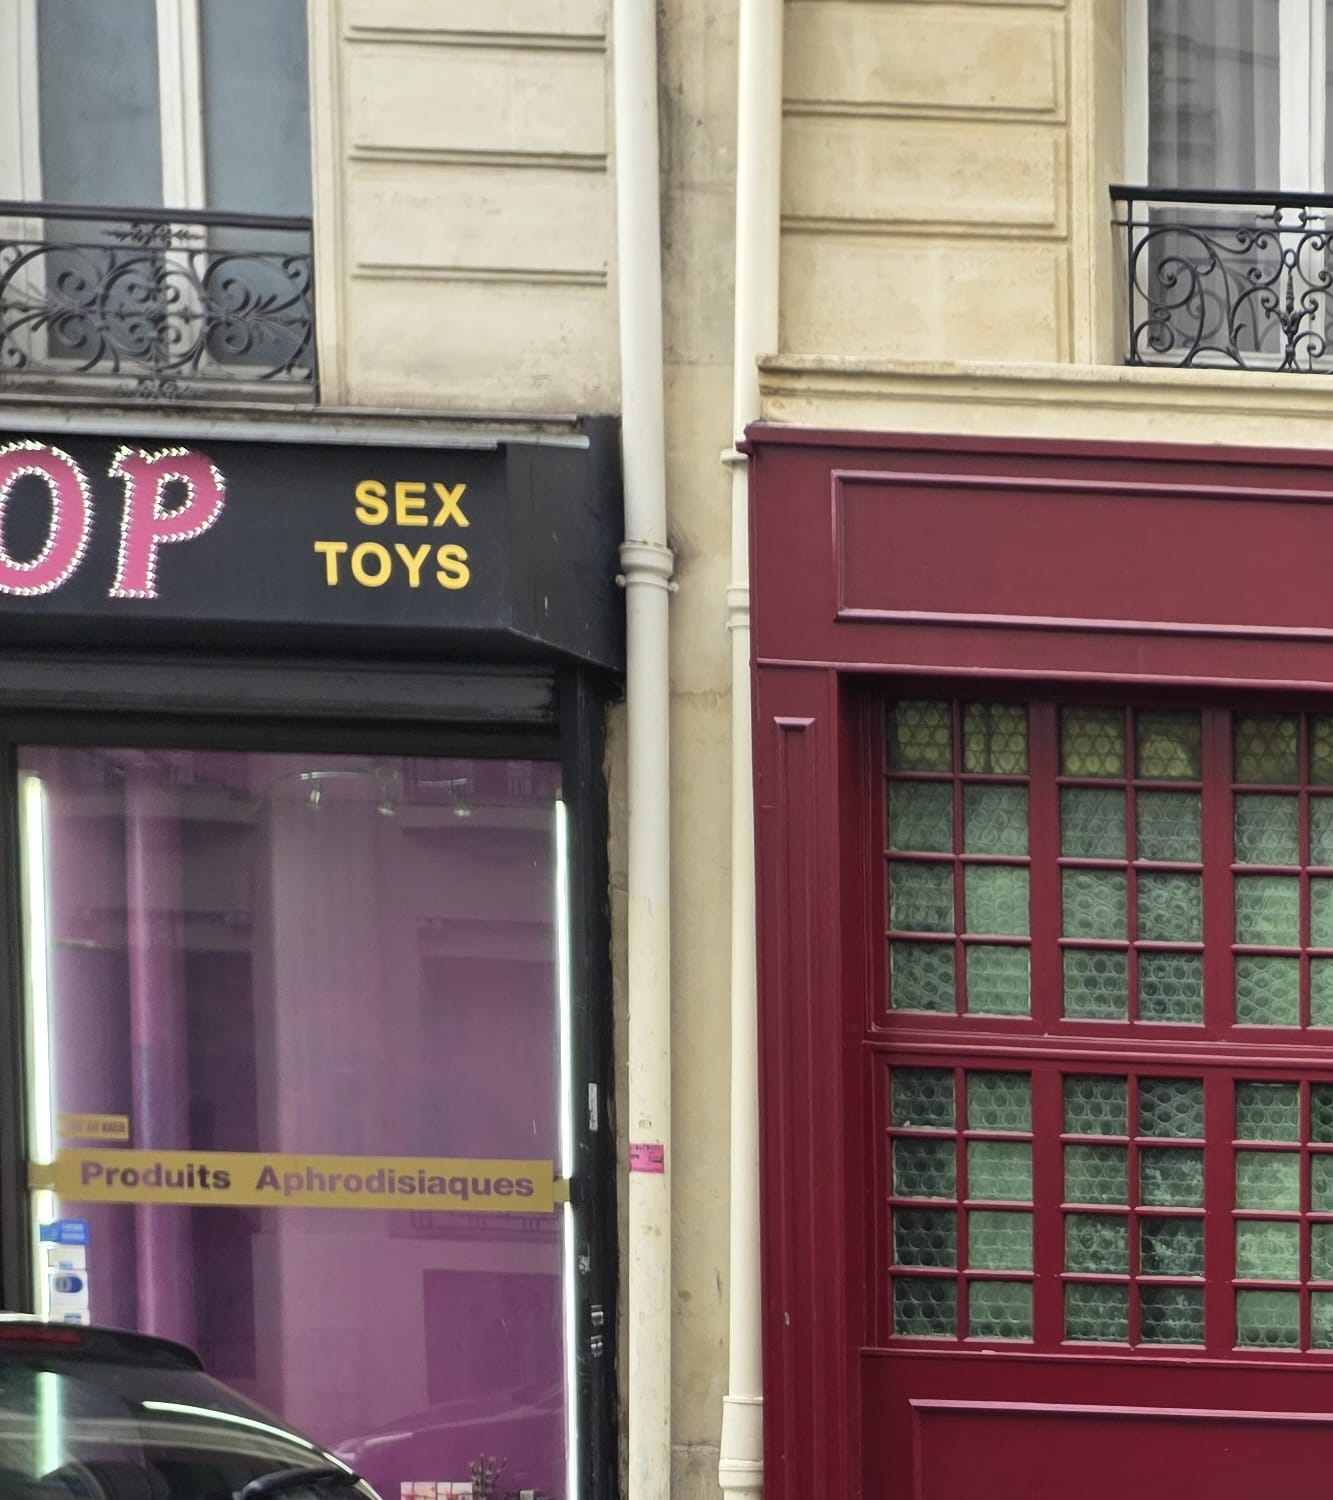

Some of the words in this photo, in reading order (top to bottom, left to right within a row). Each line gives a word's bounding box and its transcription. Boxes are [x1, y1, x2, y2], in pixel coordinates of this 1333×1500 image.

[354, 480, 470, 527] SEX
[314, 541, 471, 588] TOYS
[81, 1160, 232, 1189] Produits
[256, 1165, 535, 1199] Aphrodisiaques
